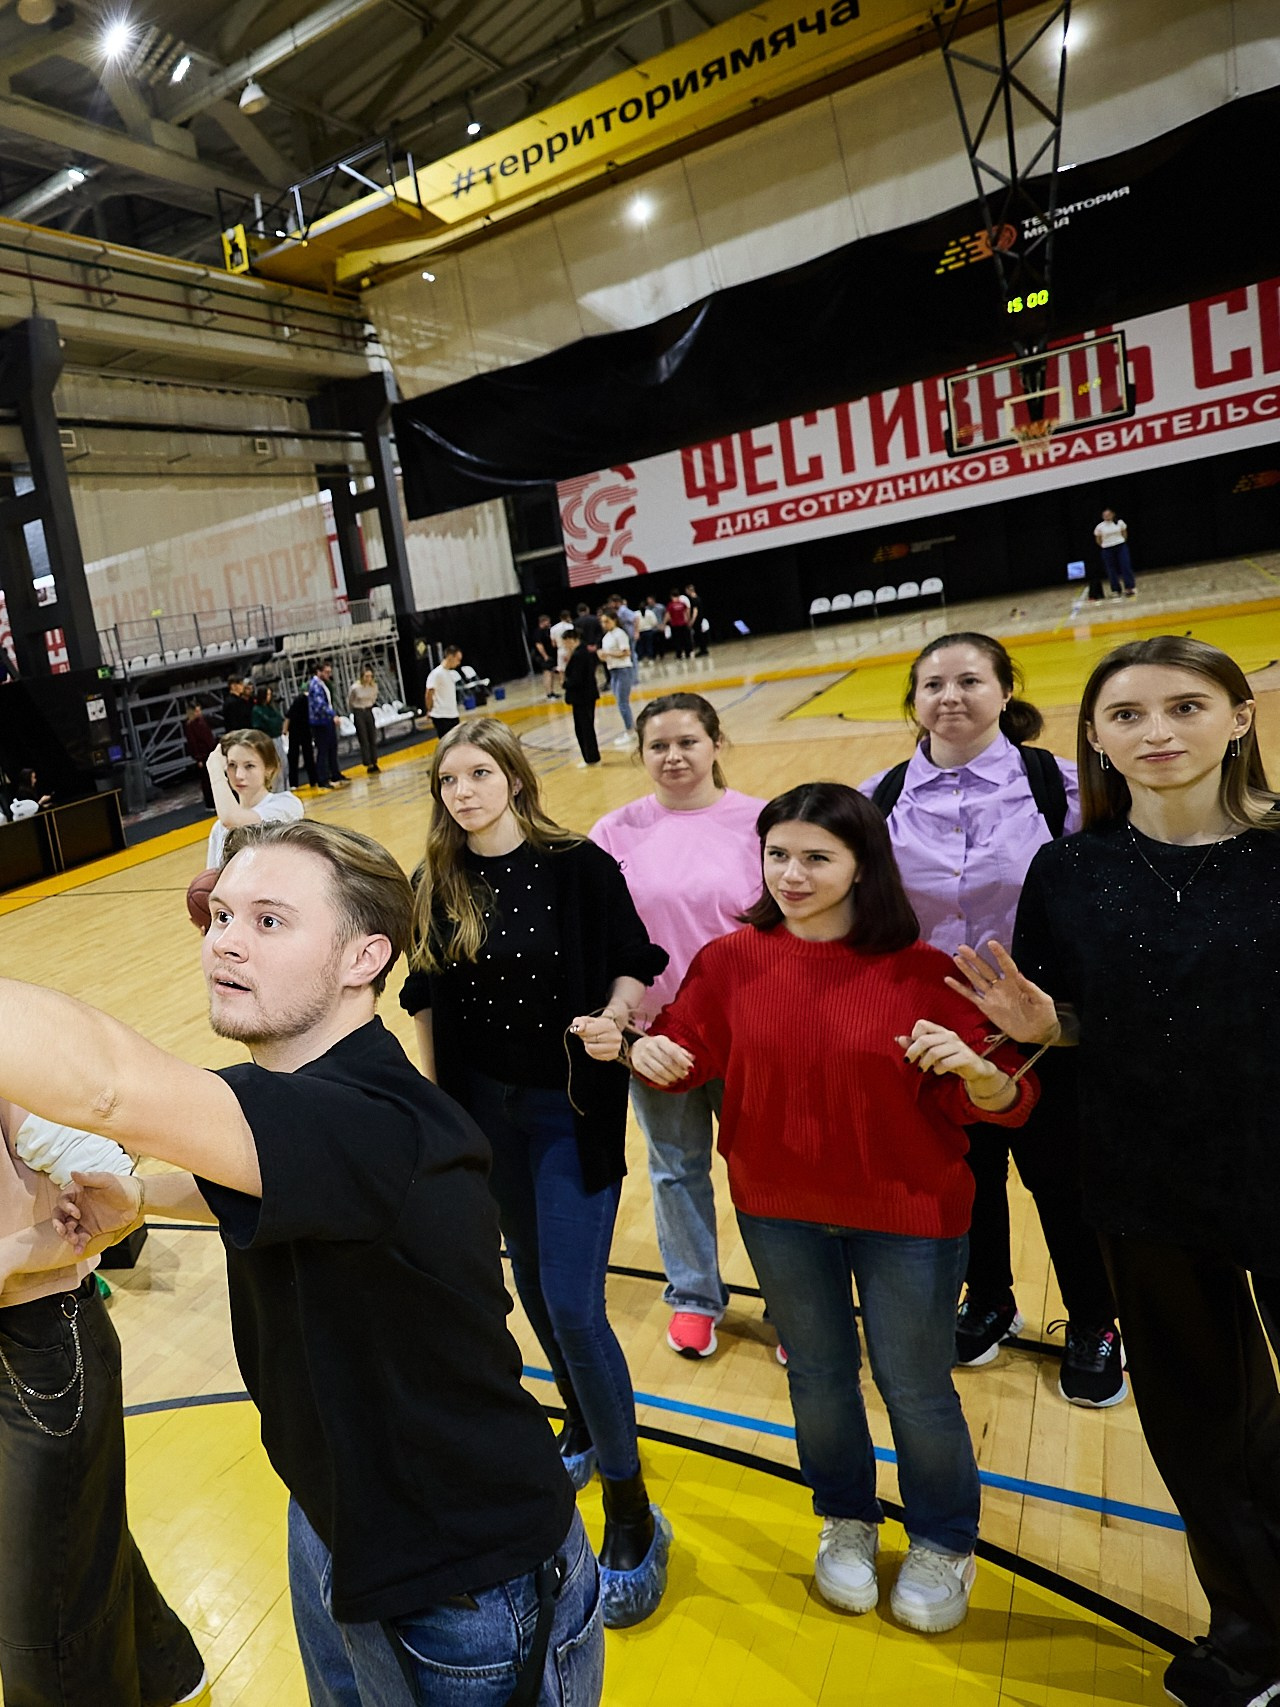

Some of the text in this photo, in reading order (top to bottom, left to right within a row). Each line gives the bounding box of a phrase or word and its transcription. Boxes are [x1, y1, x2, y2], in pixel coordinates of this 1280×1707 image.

[452, 0, 861, 199] #территориямяча
[715, 508, 769, 539] ДЛЯ
[780, 455, 1010, 522] СОТРУДНИКОВ
